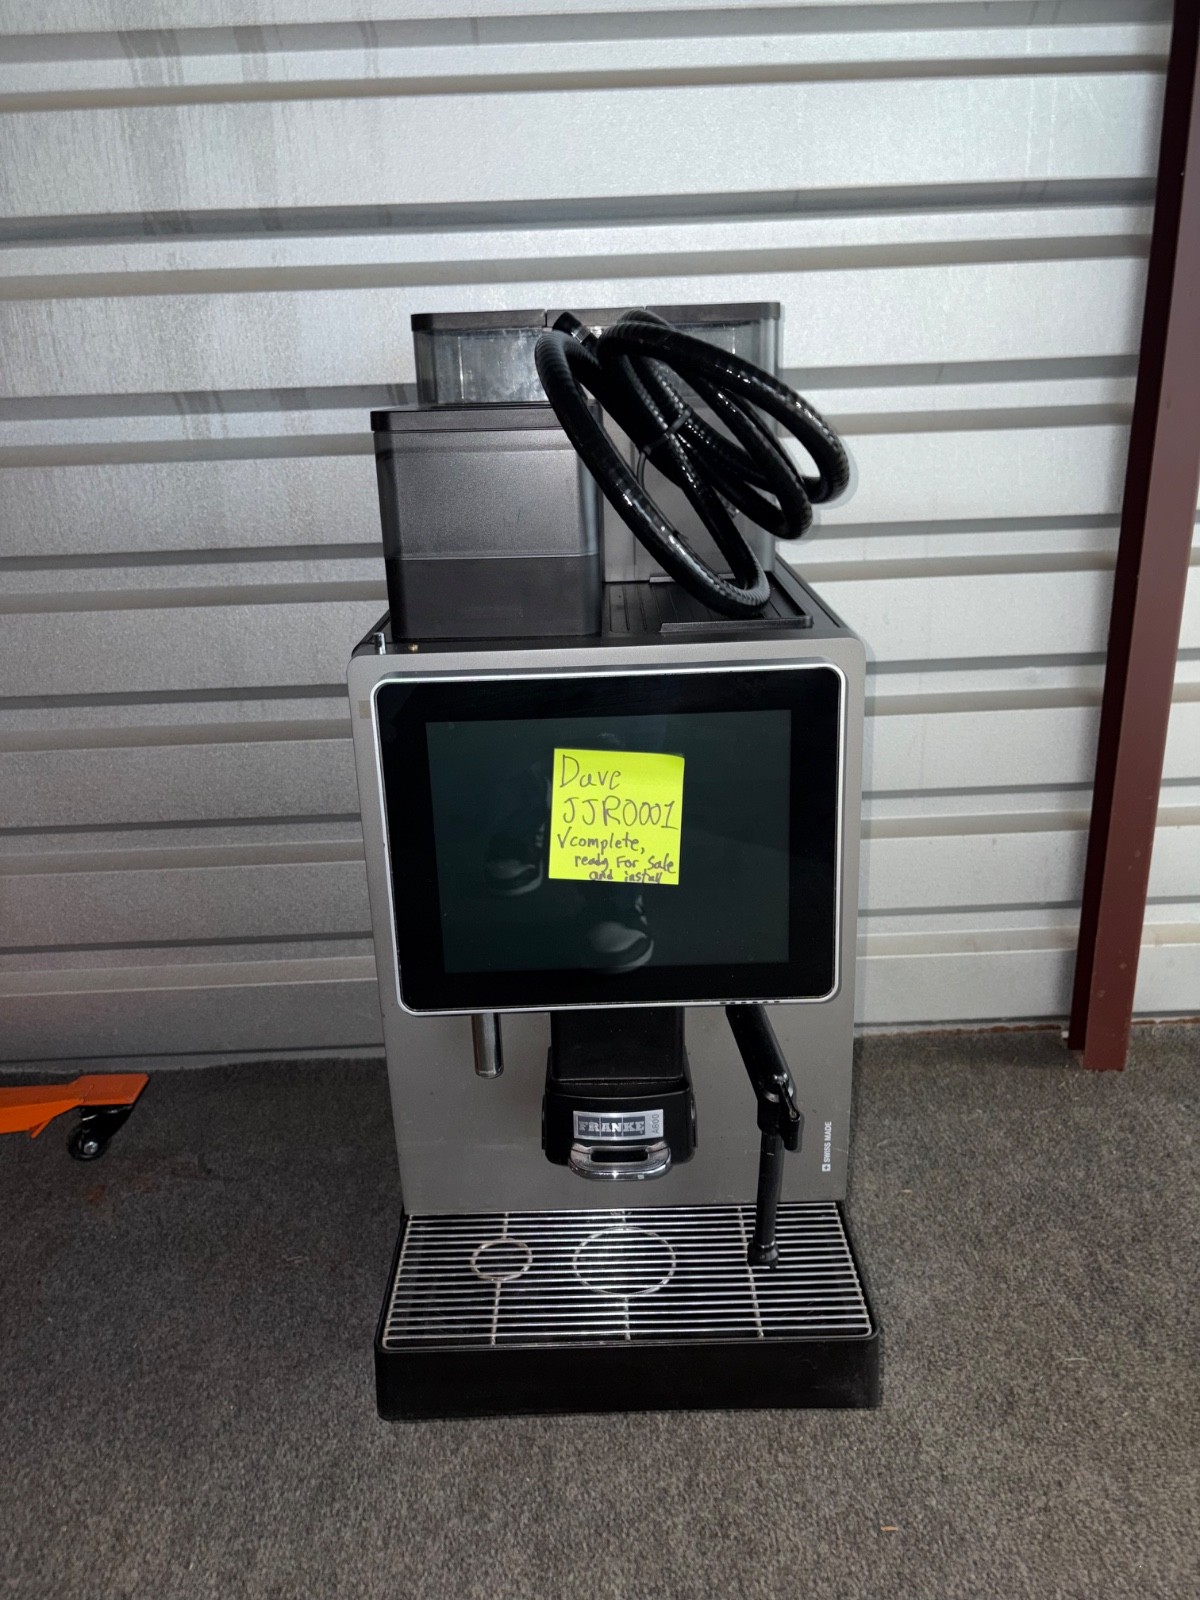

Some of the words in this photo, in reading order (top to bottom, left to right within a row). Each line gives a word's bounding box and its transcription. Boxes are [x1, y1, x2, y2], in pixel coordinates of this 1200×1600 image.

[559, 754, 621, 790] Dave
[574, 853, 609, 871] ready
[616, 855, 639, 868] For
[588, 868, 614, 881] and
[578, 1120, 646, 1134] FRANKE
[824, 1121, 832, 1141] MADE
[823, 1142, 831, 1163] SWISS
